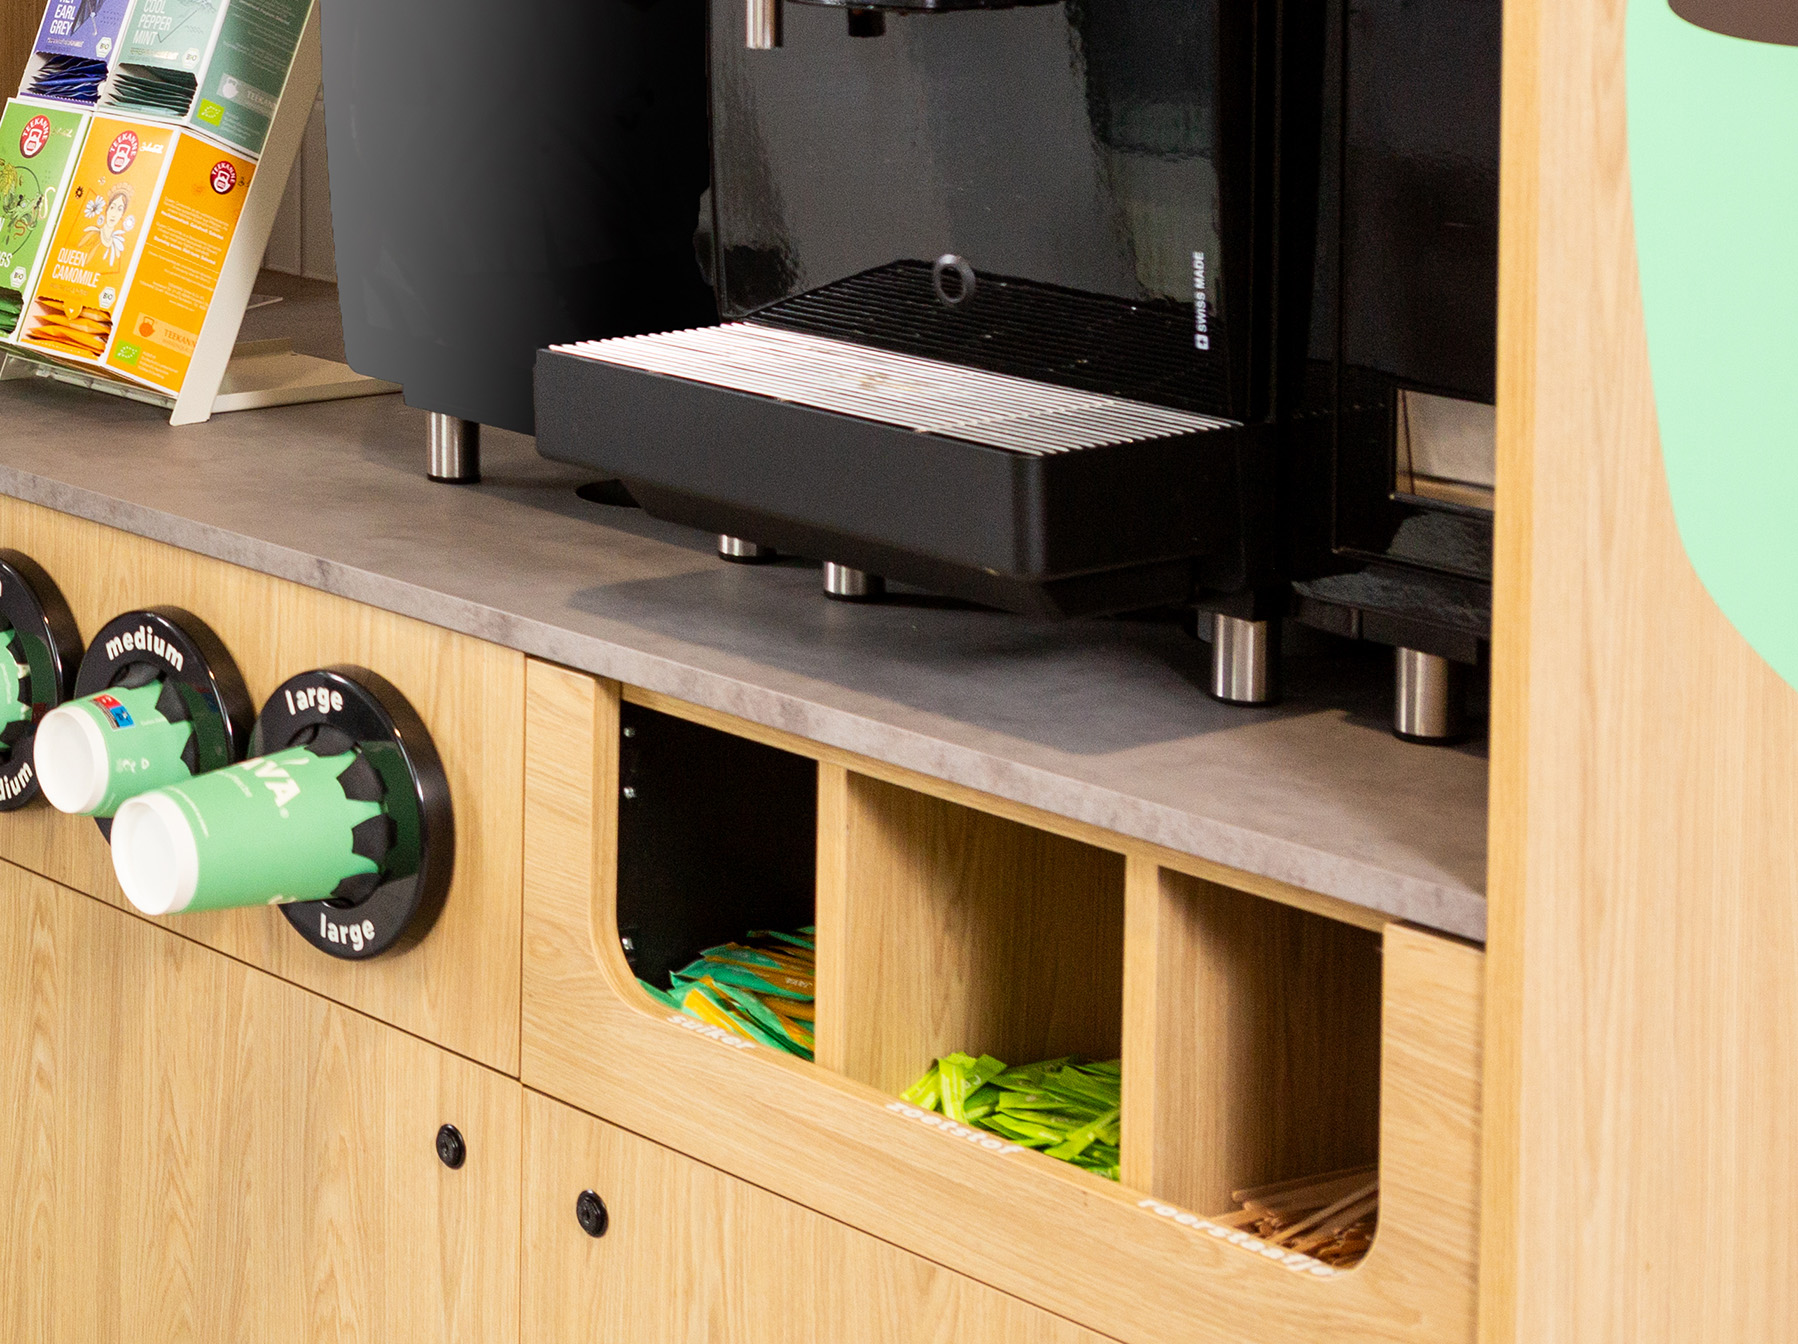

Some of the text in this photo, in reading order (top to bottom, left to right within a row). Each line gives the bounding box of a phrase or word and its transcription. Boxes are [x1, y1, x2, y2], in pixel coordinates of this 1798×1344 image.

[54, 4, 76, 20] EARL
[138, 14, 172, 31] PEPPER
[49, 20, 74, 36] GREY
[132, 30, 159, 46] MINT
[22, 117, 50, 141] TEEKANNE
[109, 133, 137, 157] TEEKANNE
[211, 162, 236, 184] TEEKANNE
[57, 248, 88, 267] QUEEN
[52, 264, 101, 288] CAMOMILE
[1193, 250, 1207, 333] SWISS MADE
[105, 625, 184, 672] medium
[285, 686, 344, 716] large
[320, 912, 376, 952] large
[667, 1014, 756, 1050] suiker
[885, 1101, 1026, 1155] zoetstof
[1137, 1198, 1336, 1277] roerstaafje
